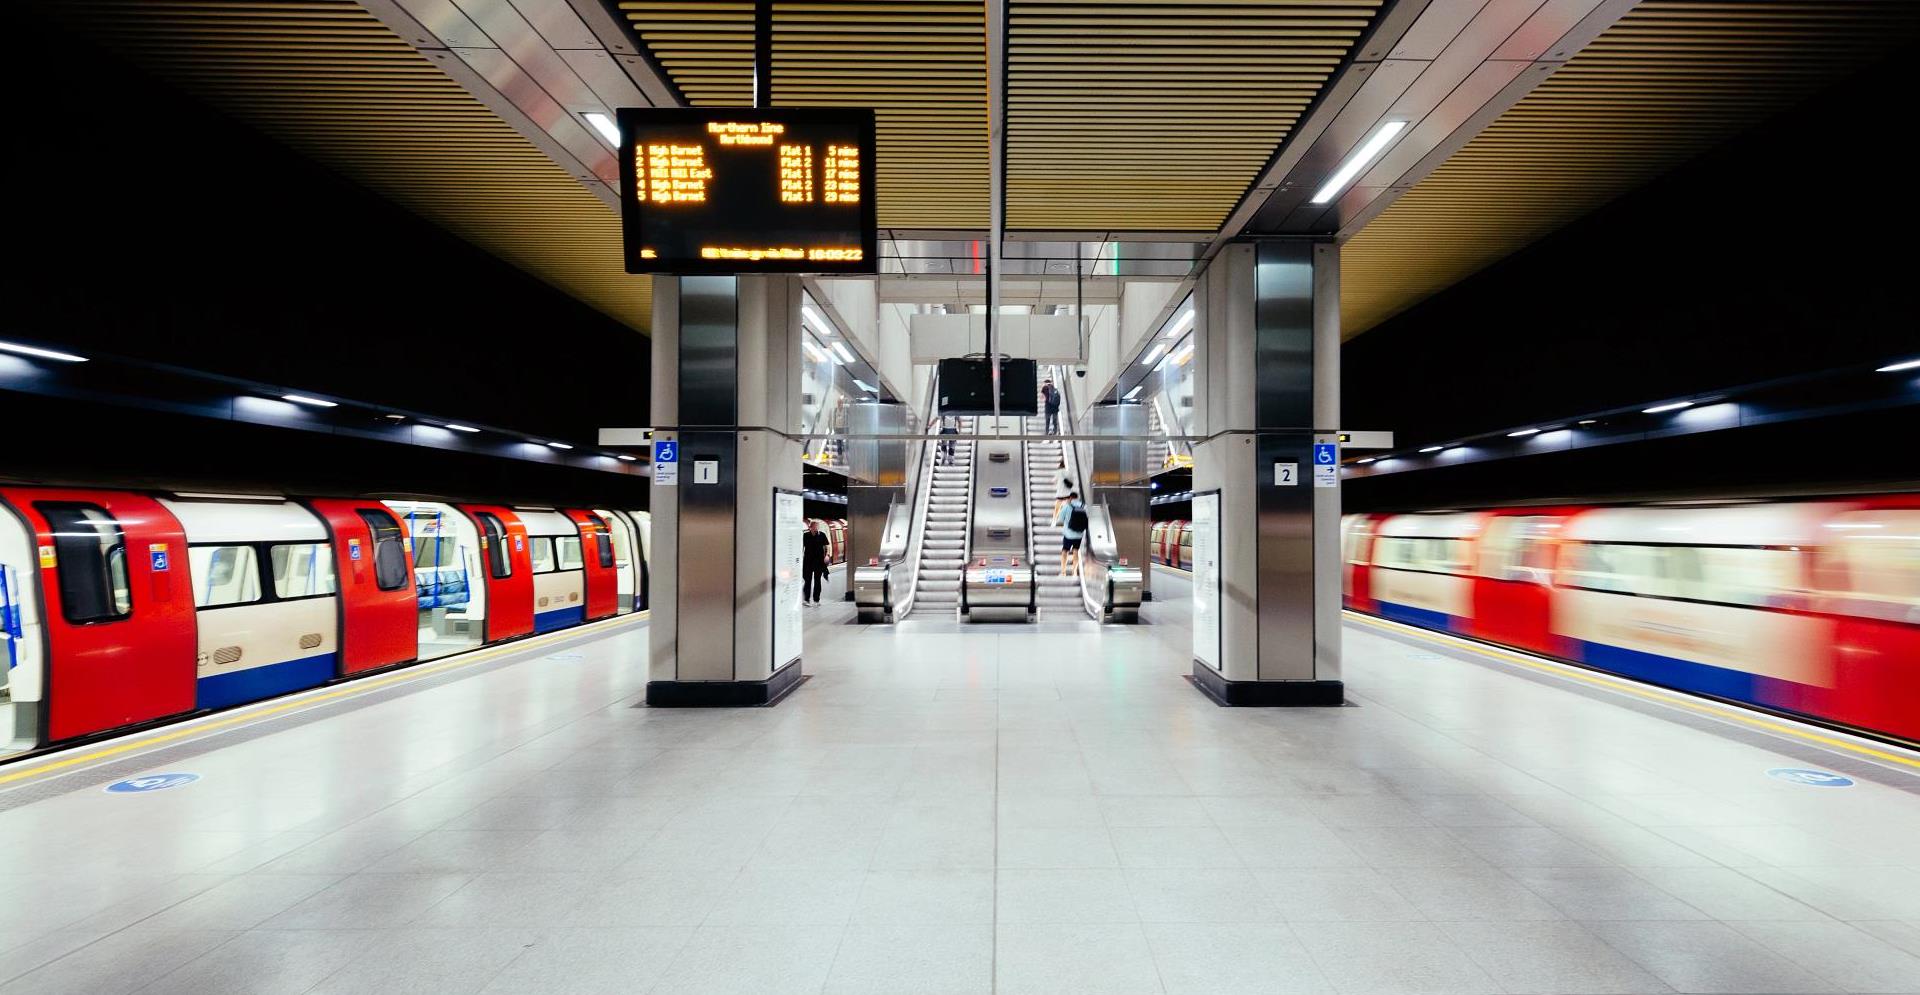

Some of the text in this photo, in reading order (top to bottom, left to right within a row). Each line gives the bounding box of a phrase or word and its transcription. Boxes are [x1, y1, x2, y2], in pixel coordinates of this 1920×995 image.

[708, 122, 784, 134] Northern line
[719, 134, 774, 145] Northbound
[636, 145, 859, 157] 1 High Barnet Plat 1 5 mins
[635, 156, 859, 168] 2 High Barnet Plat 2 11 mins
[636, 168, 860, 180] 3 Mill Hill East Plat 1 17 mins
[637, 179, 860, 192] 4 High Barnet Plat 2 23 mins
[637, 190, 860, 203] 5 High Barnet Plat 1 29 mins
[1282, 469, 1291, 482] 2
